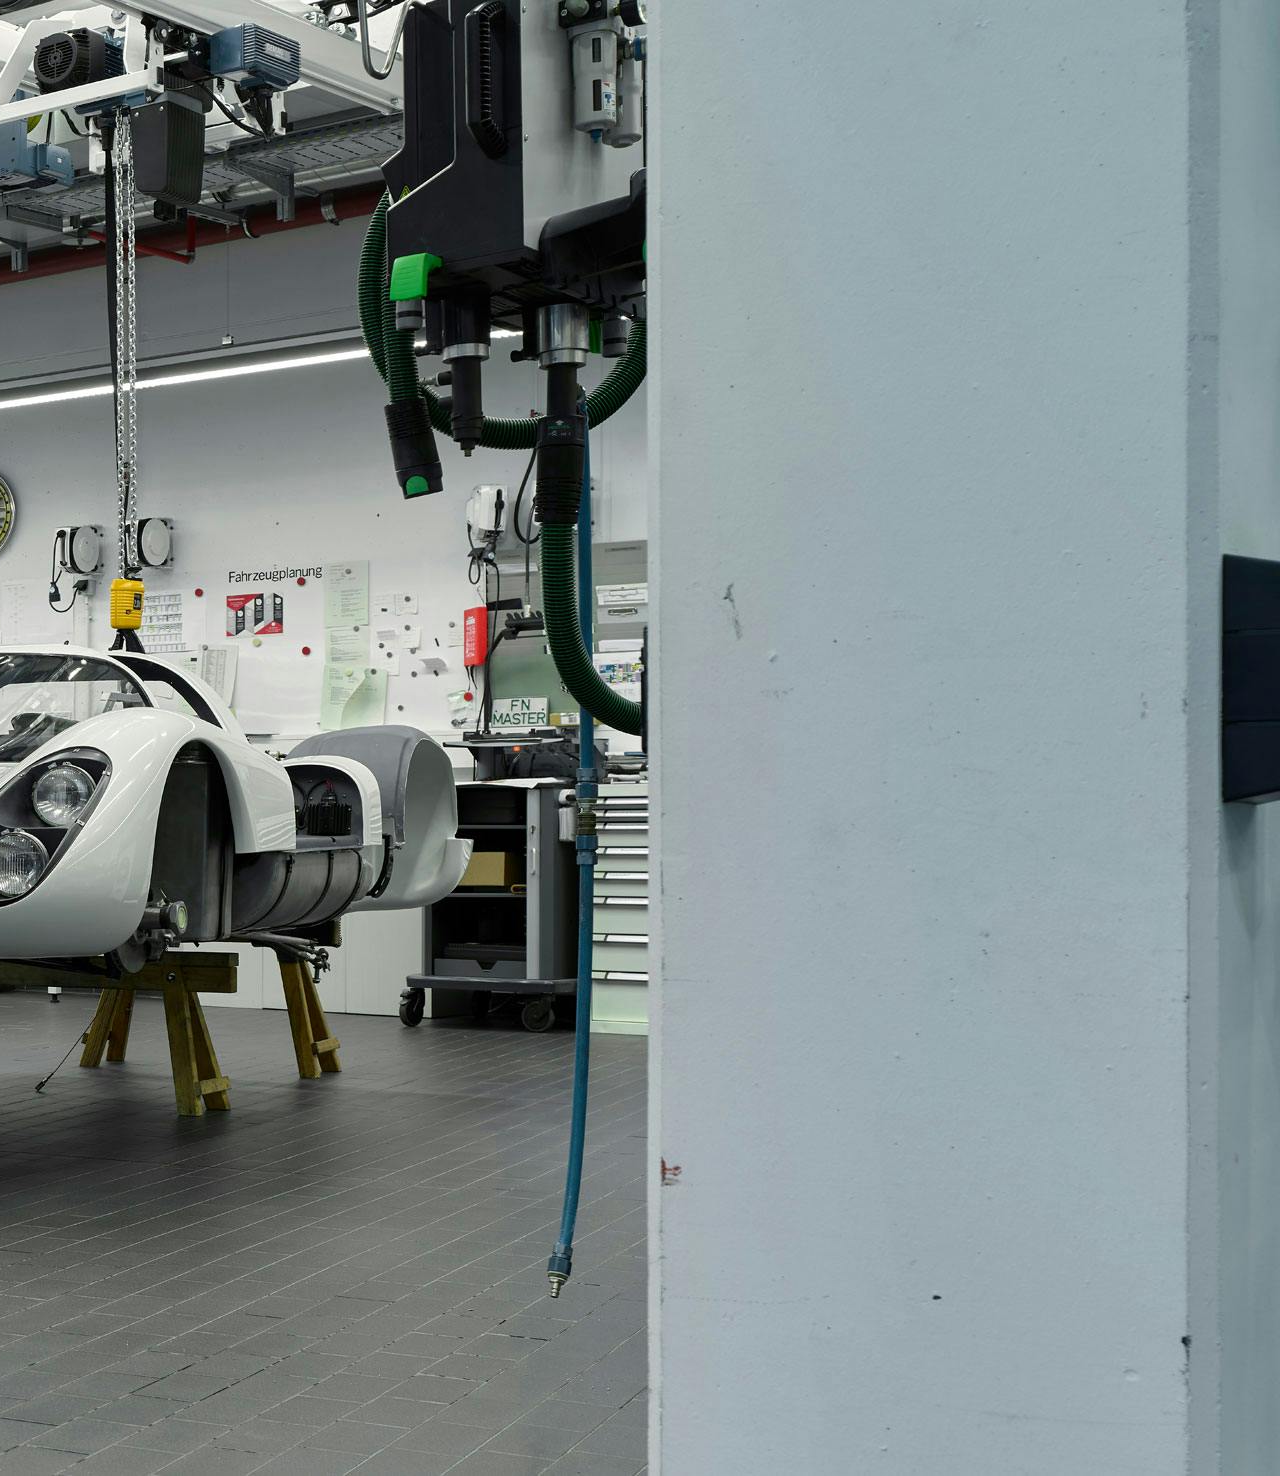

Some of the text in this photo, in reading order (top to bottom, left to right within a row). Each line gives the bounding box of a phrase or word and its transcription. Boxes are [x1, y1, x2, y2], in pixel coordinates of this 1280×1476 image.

[228, 566, 323, 583] Fahrzeugplanung
[511, 699, 530, 711] FN
[493, 712, 546, 725] MASTER
